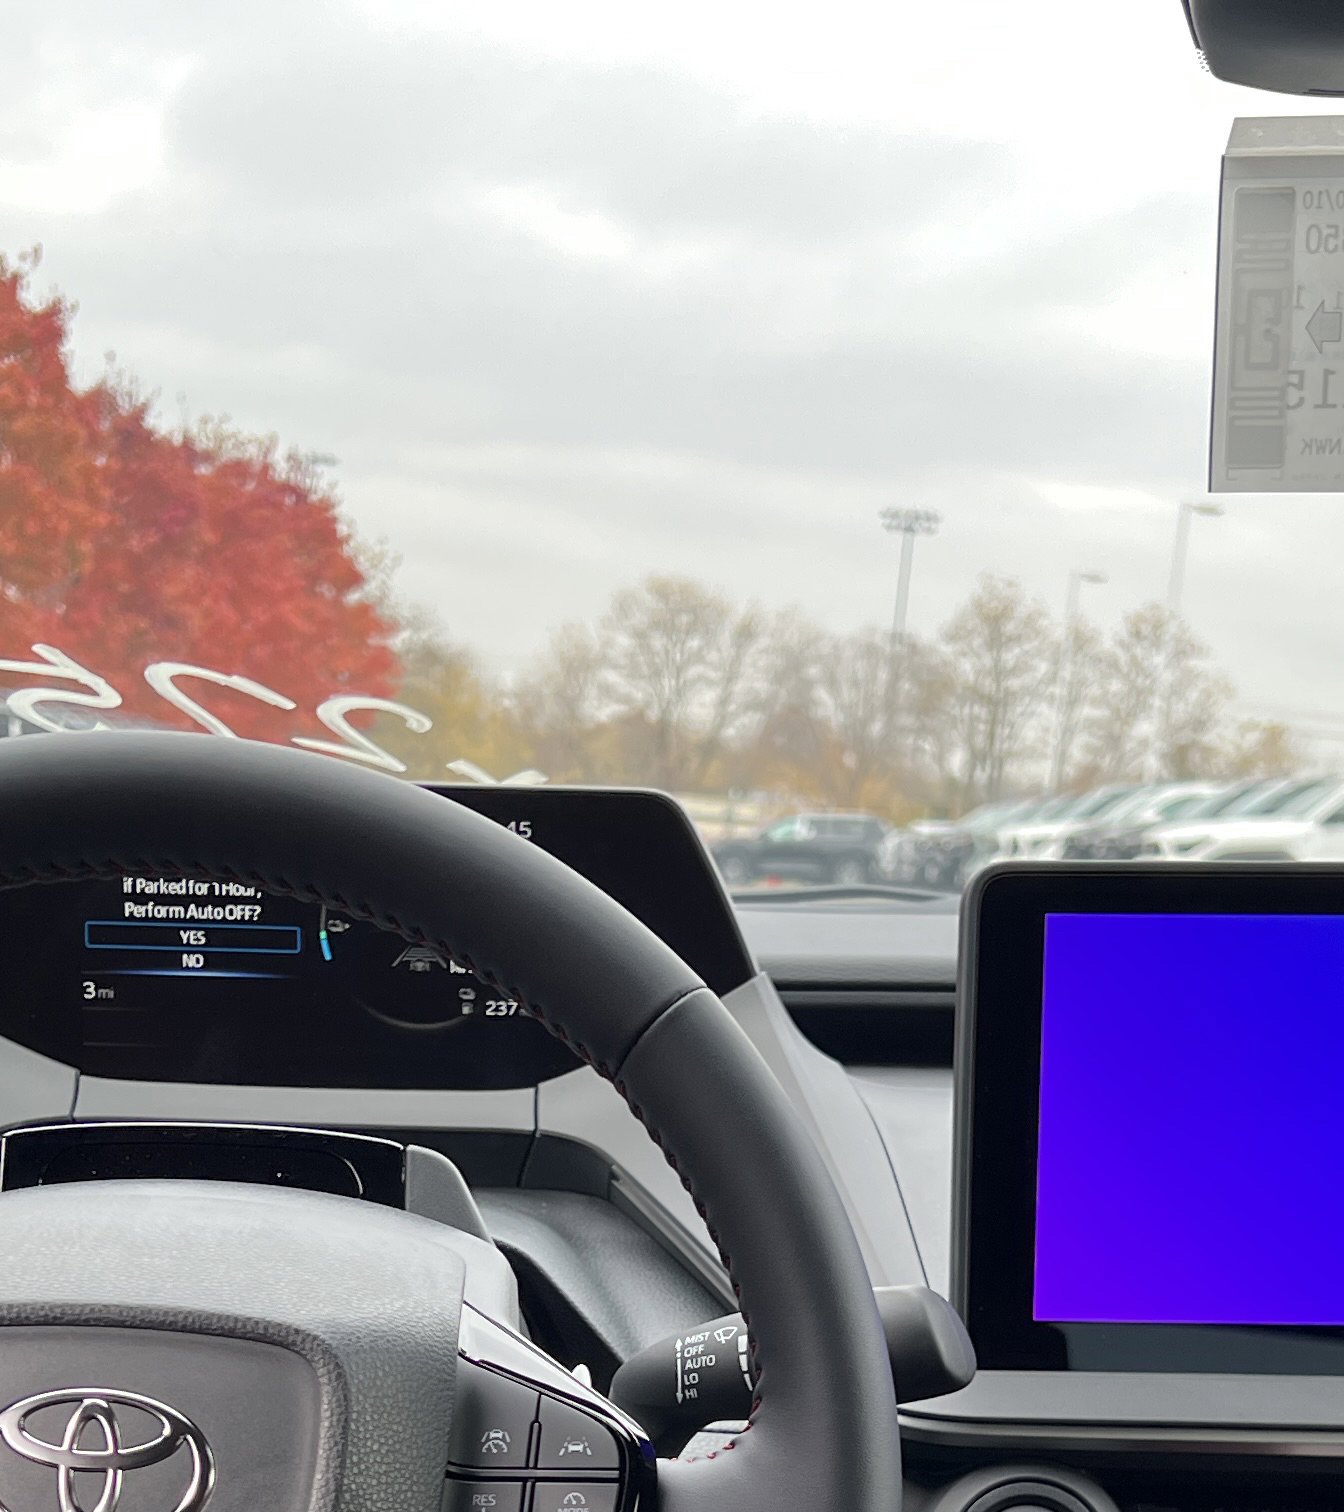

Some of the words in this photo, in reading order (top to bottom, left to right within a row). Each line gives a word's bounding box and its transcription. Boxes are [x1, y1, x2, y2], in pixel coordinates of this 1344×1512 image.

[136, 878, 186, 896] Parked
[188, 880, 211, 896] for
[124, 902, 185, 919] Perform
[186, 904, 224, 920] Auto
[225, 905, 262, 921] OFF?
[180, 930, 206, 945] YES
[182, 954, 204, 969] NO
[82, 981, 96, 999] 3
[97, 987, 114, 999] mi
[485, 1000, 519, 1016] 237
[684, 1331, 710, 1346] MIST
[683, 1344, 705, 1358] OFF
[684, 1355, 716, 1371] AUTO
[683, 1373, 699, 1386] LO
[684, 1388, 698, 1400] HI
[472, 1494, 497, 1506] RES
